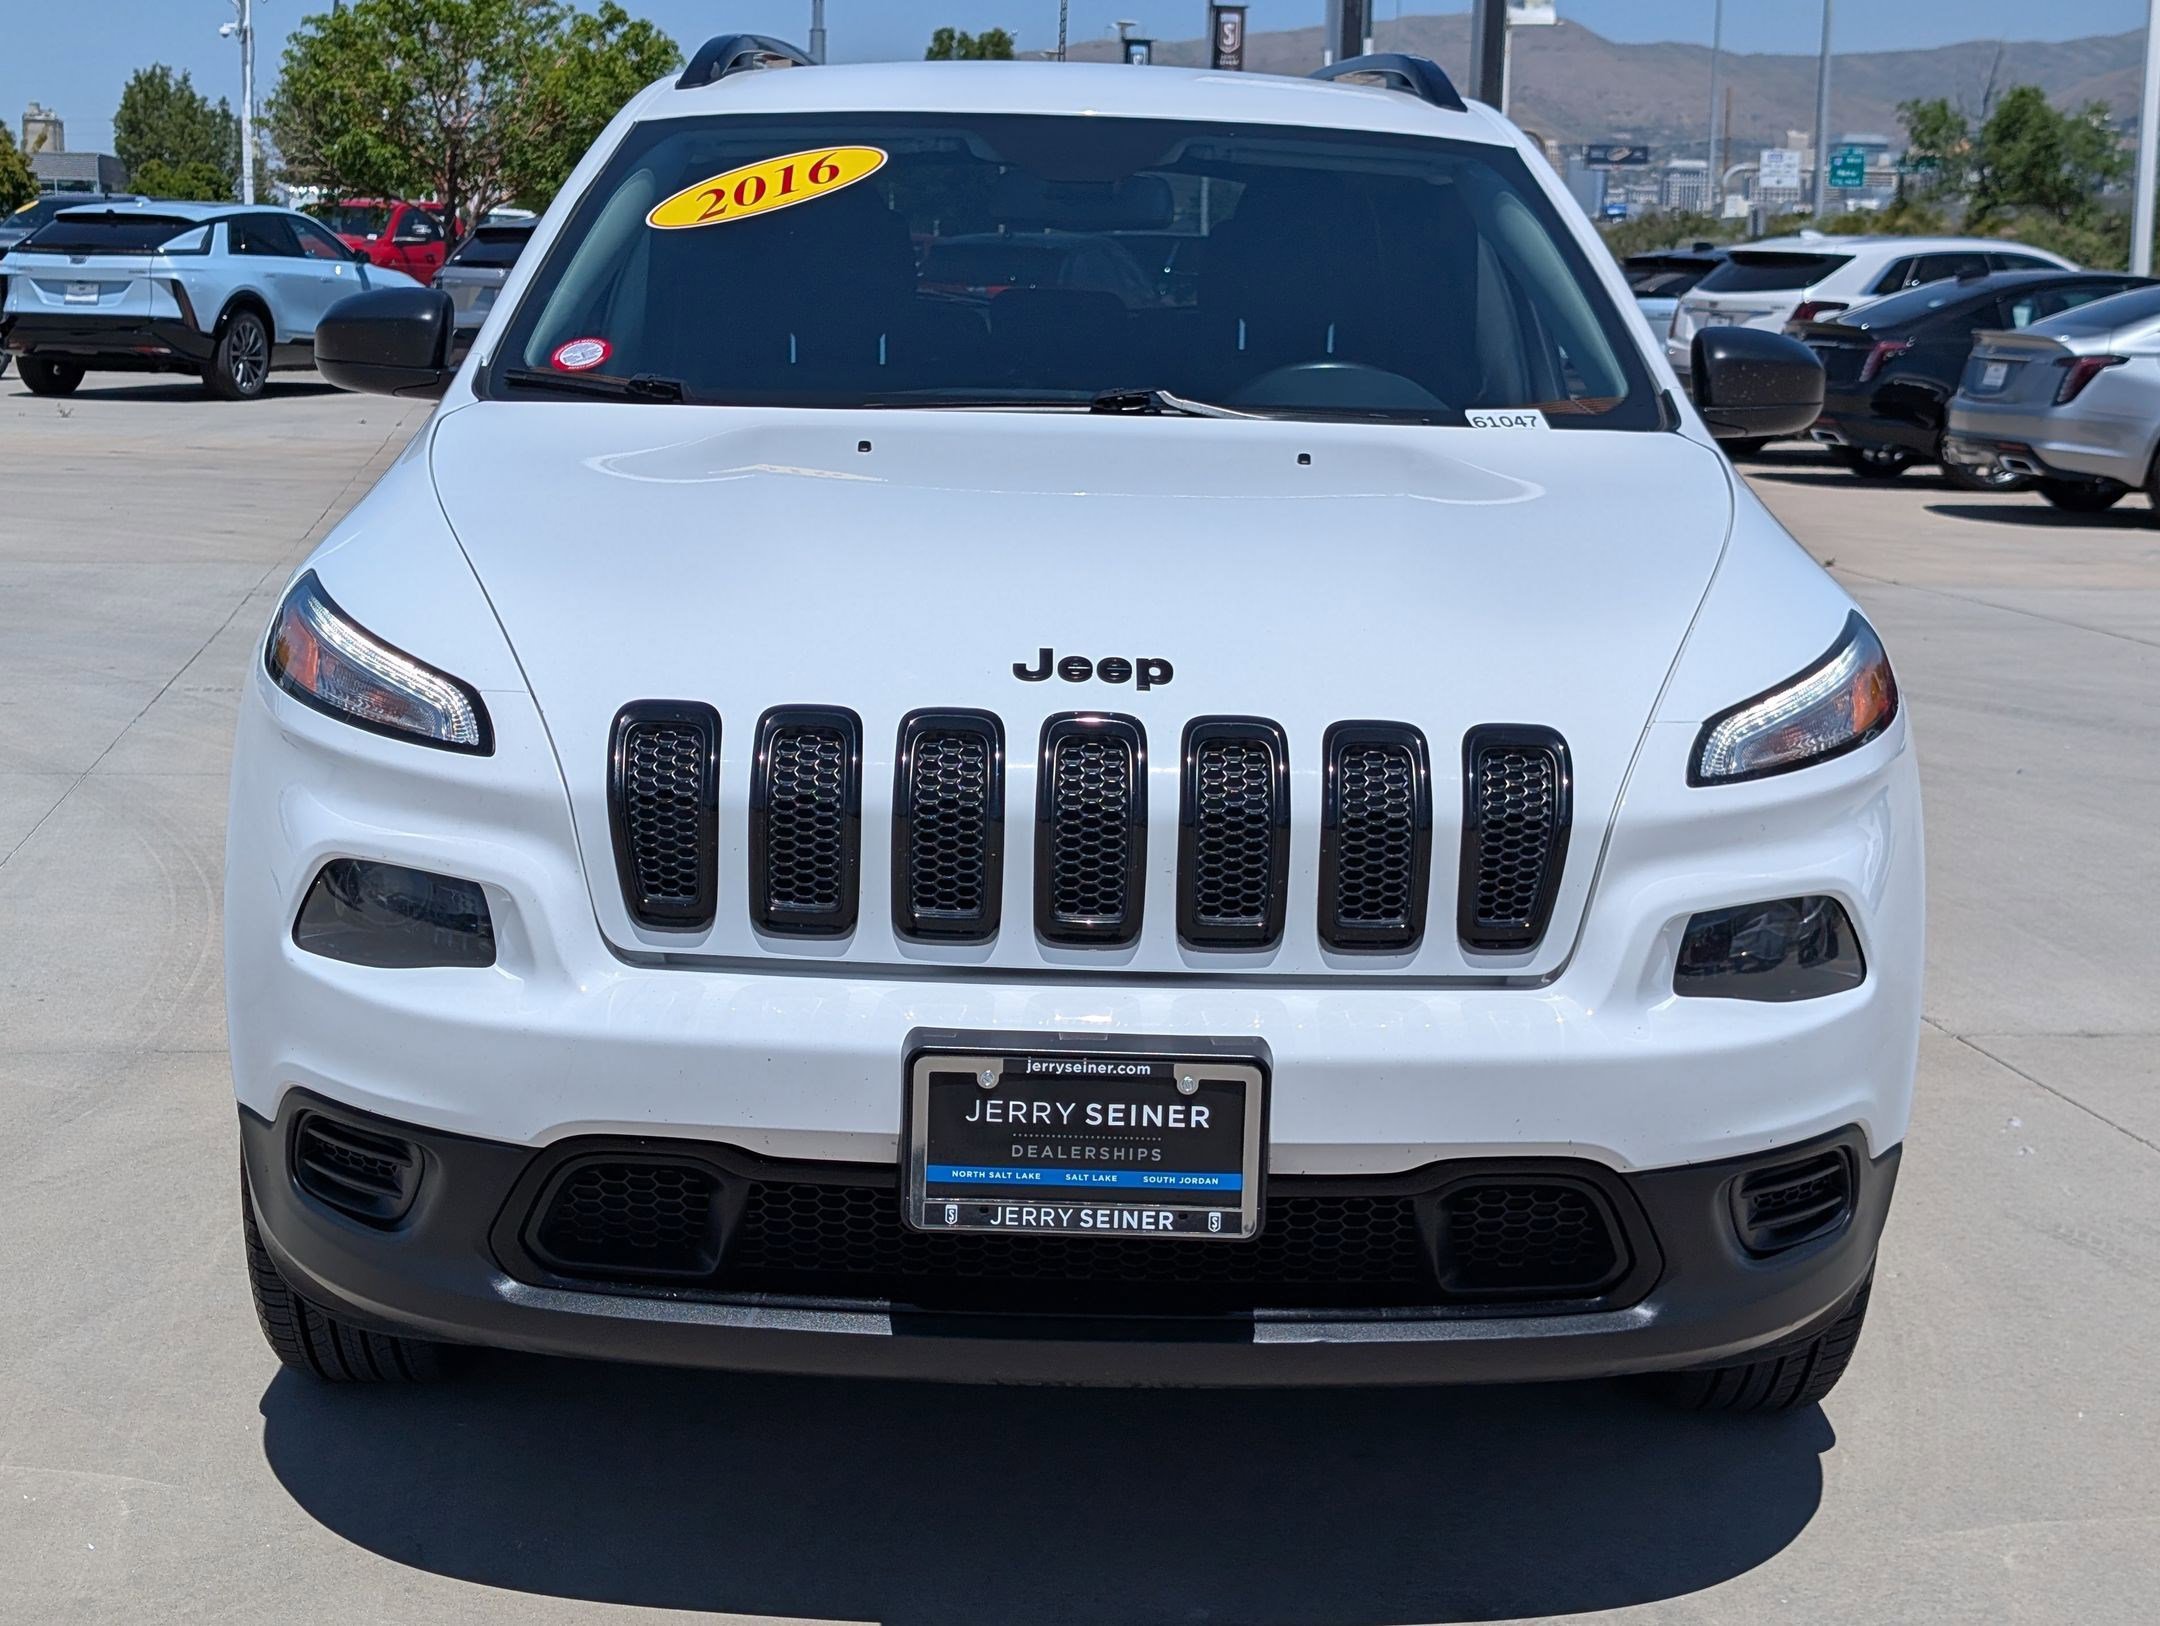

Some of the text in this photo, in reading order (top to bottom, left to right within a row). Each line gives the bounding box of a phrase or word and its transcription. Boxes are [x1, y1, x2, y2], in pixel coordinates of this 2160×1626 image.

[695, 152, 840, 222] 2016
[1472, 415, 1537, 428] 61047
[1012, 647, 1174, 691] Jeep
[1025, 1056, 1151, 1075] jerryseiner.com
[965, 1099, 1210, 1128] JERRY SEINER
[1011, 1144, 1162, 1161] DEALERSHIPS
[952, 1170, 1041, 1180] NORTH SALT LAKE
[1065, 1173, 1118, 1182] SALT LAKE
[1143, 1175, 1219, 1185] SOUTH JORDAN
[990, 1206, 1174, 1230] JERRY SEINER
